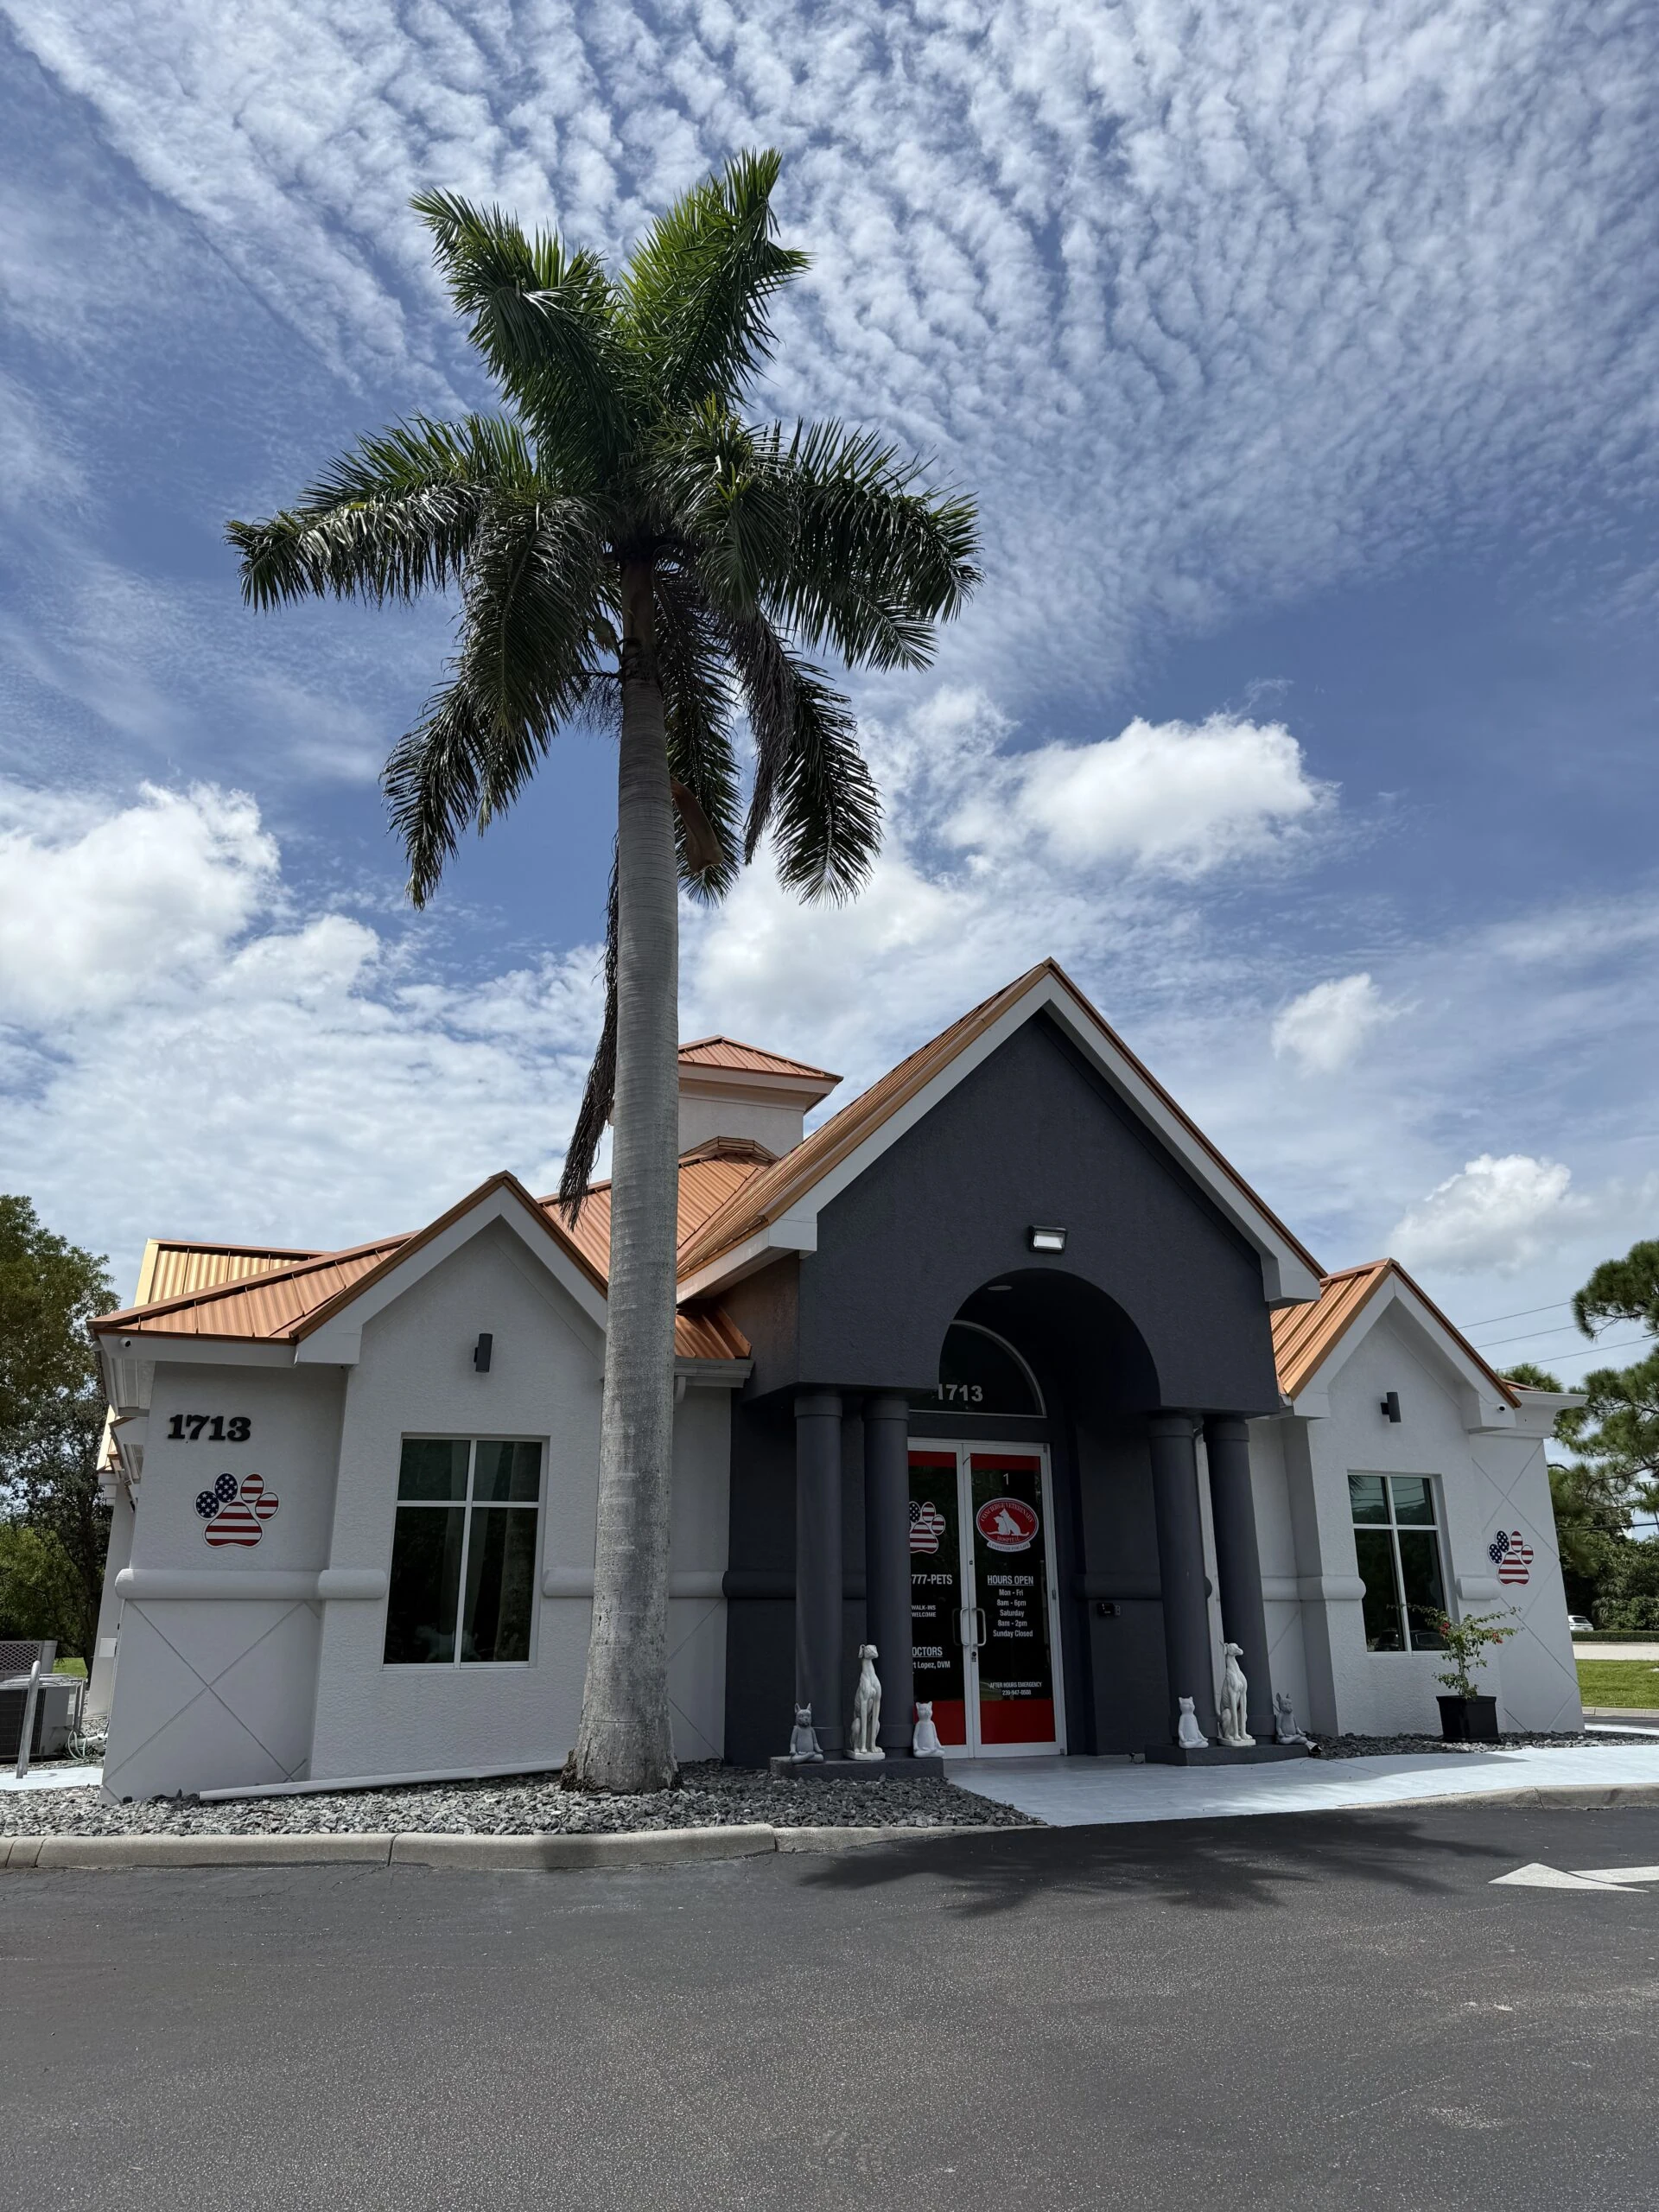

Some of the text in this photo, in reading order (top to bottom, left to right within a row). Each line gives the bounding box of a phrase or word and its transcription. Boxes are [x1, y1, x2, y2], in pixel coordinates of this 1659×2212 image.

[938, 1383, 983, 1402] 1713
[168, 1414, 251, 1441] 1713
[981, 1503, 1034, 1522] CONCIERGE VETERINARY
[911, 1573, 953, 1585] 777-PETS
[987, 1574, 1034, 1585] HOURS OPEN
[1000, 1609, 1025, 1618] Saturday
[1014, 1619, 1027, 1628] 2pm
[993, 1630, 1014, 1638] Sunday
[912, 1646, 943, 1656] OCTORS
[917, 1661, 937, 1669] Lopez,
